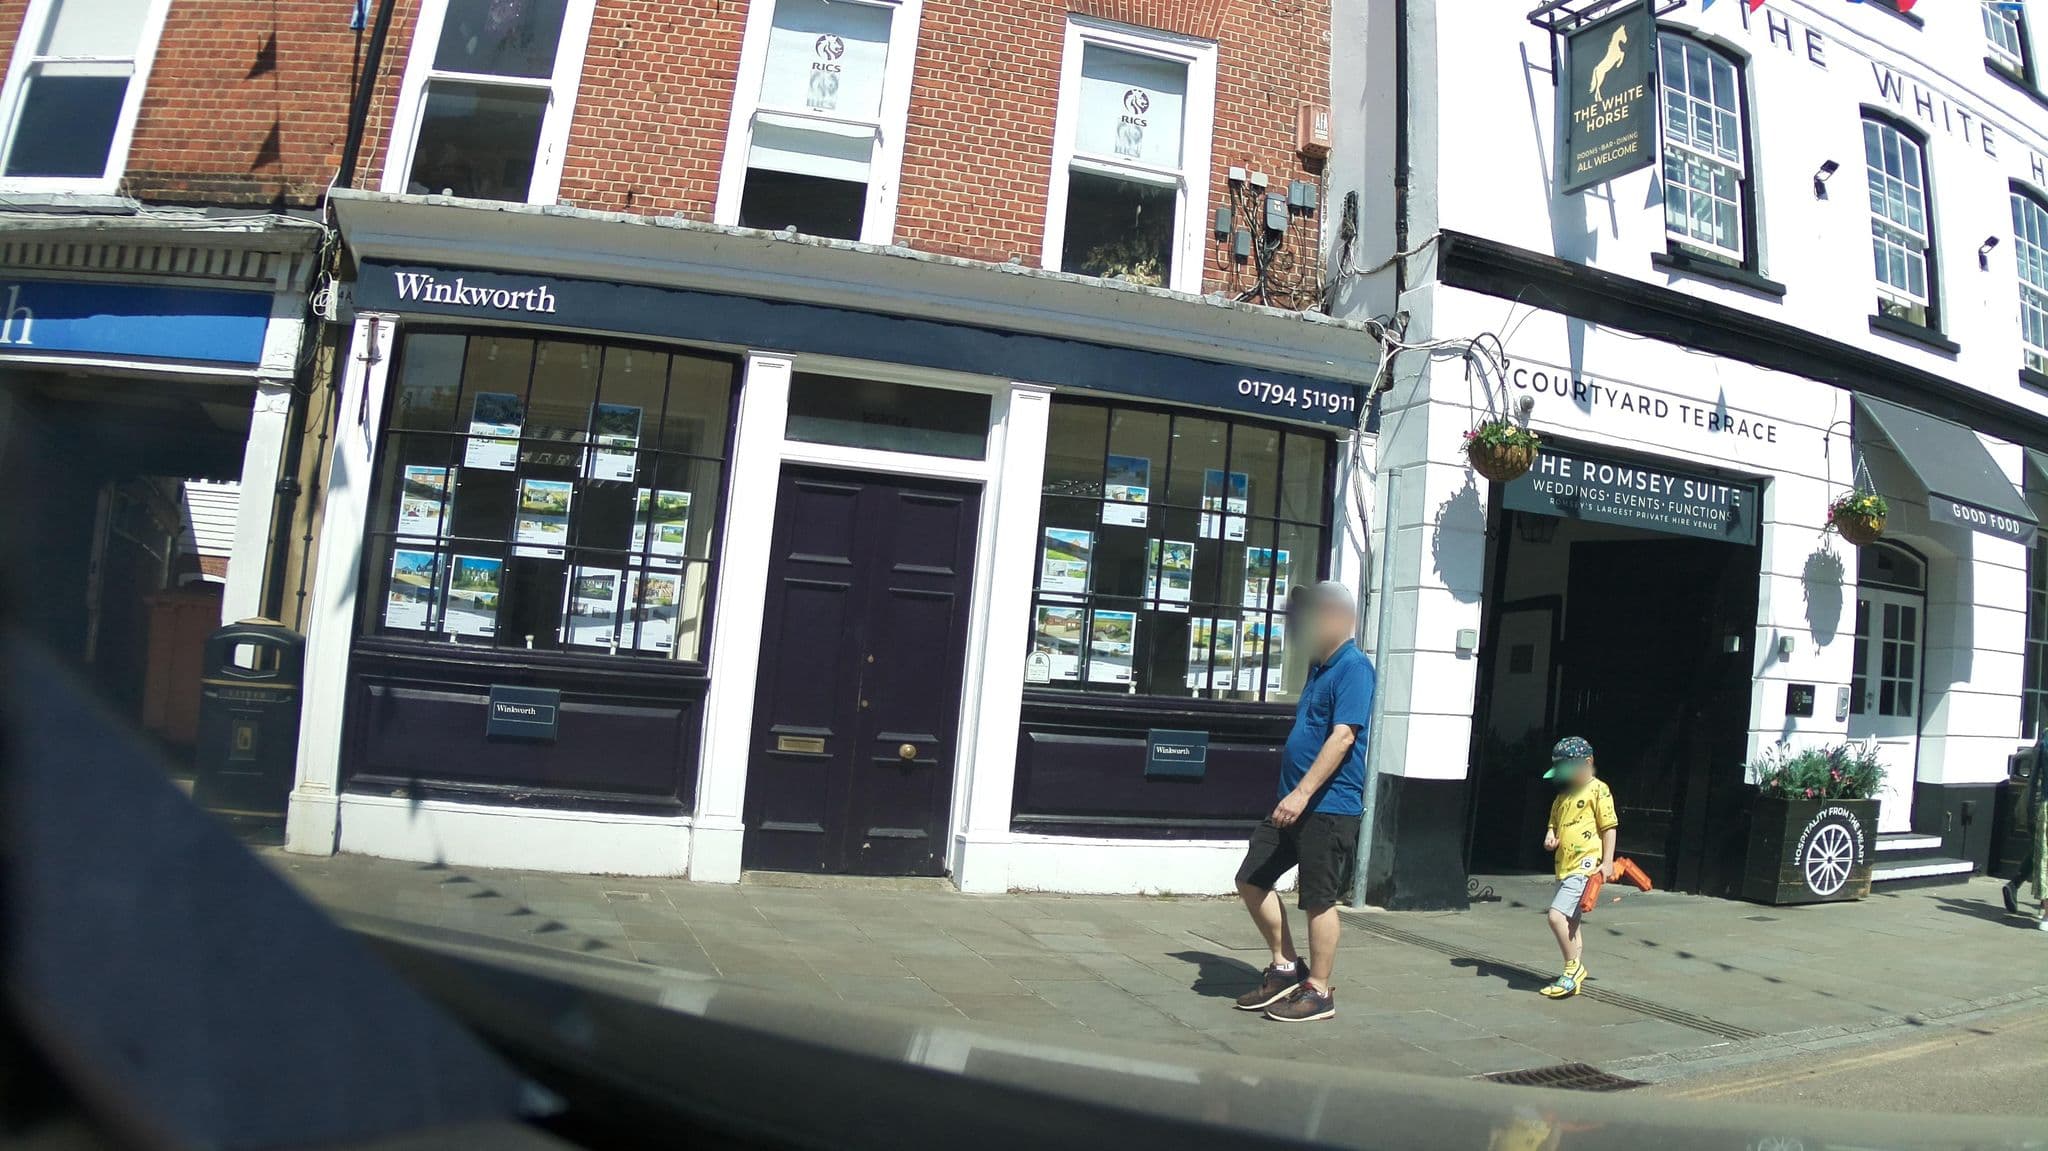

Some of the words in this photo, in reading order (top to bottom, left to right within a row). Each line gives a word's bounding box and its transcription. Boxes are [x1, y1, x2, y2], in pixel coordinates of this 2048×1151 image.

[812, 62, 842, 73] RICS
[1573, 104, 1598, 123] THE
[1602, 84, 1643, 112] WHITE
[1586, 105, 1629, 133] HORSE
[1871, 62, 1997, 158] WHITE
[1121, 115, 1148, 127] RICS
[1577, 160, 1593, 173] ALL
[1594, 141, 1638, 167] WELCOME
[394, 271, 557, 314] Winkworth
[1238, 379, 1297, 408] 01794
[1301, 389, 1356, 414] 511911
[1513, 368, 1669, 418] COURTYARD
[1679, 404, 1778, 444] TERRACE
[1583, 461, 1675, 496] ROMSEY
[1683, 480, 1742, 508] SUITE
[1596, 505, 1633, 517] LARGEST
[1636, 511, 1669, 523] PRIVATE
[1672, 517, 1691, 527] HIRE
[1693, 520, 1718, 531] VENUE
[1668, 501, 1732, 522] FUNCTIONS
[1952, 503, 1987, 525] GOOD
[1990, 514, 2020, 534] FOOD
[496, 704, 537, 716] Winkworth
[1794, 808, 1828, 866] HOSPITALITY
[1828, 806, 1850, 818] FROM
